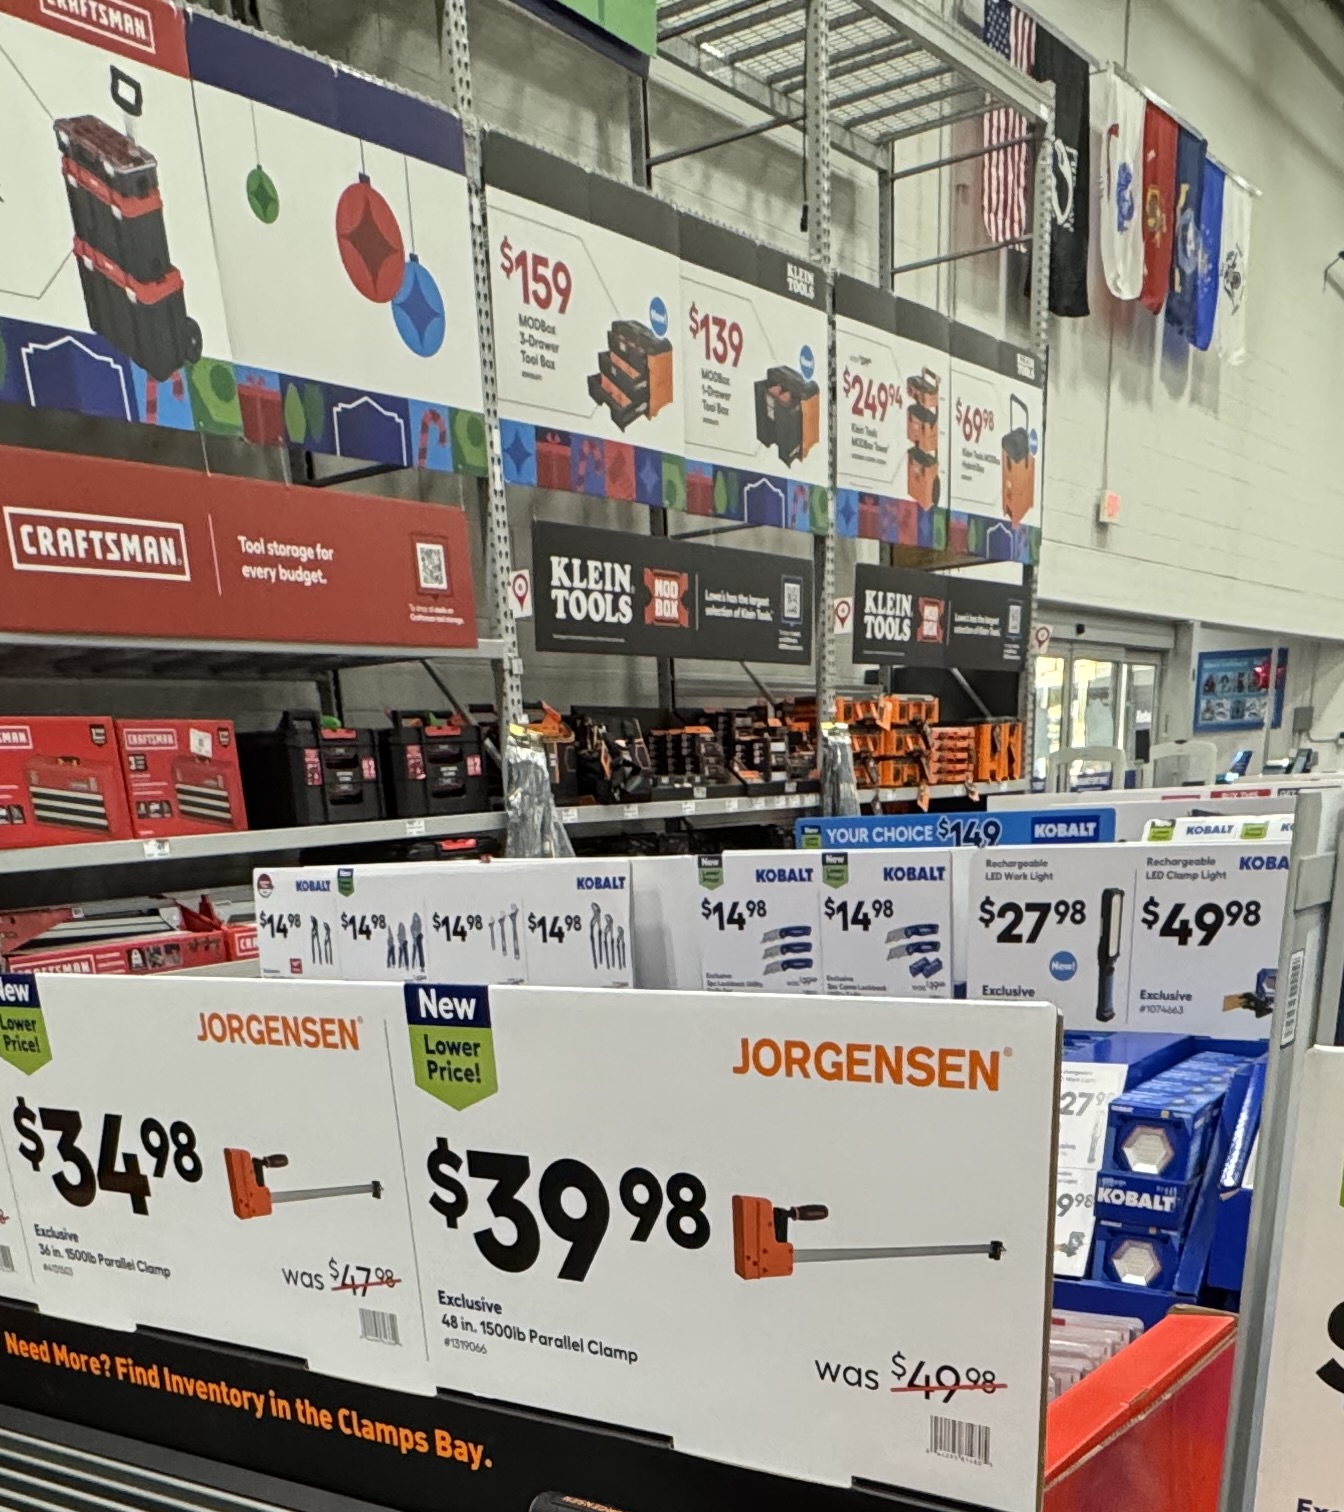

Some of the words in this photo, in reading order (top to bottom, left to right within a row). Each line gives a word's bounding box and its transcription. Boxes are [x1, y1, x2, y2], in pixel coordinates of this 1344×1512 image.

[500, 235, 572, 314] $159
[786, 262, 815, 284] KLEIN
[787, 277, 816, 300] TOOLS
[519, 313, 557, 336] MODBox
[689, 302, 743, 368] $139
[519, 332, 560, 354] 3-Drawer
[19, 523, 178, 565] CRAFTSMAN
[238, 534, 265, 554] Tool
[266, 541, 314, 562] storage
[315, 545, 334, 562] for
[241, 565, 276, 583] every
[278, 564, 327, 585] budget.
[551, 557, 632, 594] KLEIN
[654, 578, 679, 600] MOD
[552, 588, 633, 625] TOOLS
[655, 599, 679, 620] BOX
[864, 589, 912, 617] KLEIN
[864, 613, 912, 642] TOOLS
[826, 826, 869, 844] YOUR
[872, 825, 933, 842] CHOICE
[937, 817, 1001, 848] $149
[1033, 821, 1097, 839] KOBALT
[1186, 824, 1234, 836] KOBALT
[824, 854, 845, 865] New
[986, 858, 1048, 870] Rechargeable
[295, 880, 331, 892] KOBALT
[576, 876, 626, 890] KOBALT
[755, 867, 814, 884] KOBALT
[882, 866, 946, 882] KOBALT
[985, 871, 1002, 881] LED
[1004, 872, 1029, 881] Work
[1030, 872, 1053, 882] Light
[1145, 870, 1164, 880] LED
[1166, 871, 1198, 882] Clamp
[1200, 871, 1227, 882] Light
[1050, 959, 1077, 973] New!
[982, 984, 1035, 998] Exclusive
[1140, 989, 1192, 1004] Exclusive
[418, 990, 476, 1021] New
[2, 1031, 40, 1055] Price!
[197, 1013, 360, 1050] JORGENSEN
[423, 1034, 481, 1059] Lower
[427, 1060, 482, 1085] Price!
[732, 1038, 1000, 1091] JORGENSEN
[1096, 1187, 1176, 1212] KOBALT
[34, 1224, 79, 1244] Exclusive
[282, 1266, 325, 1290] was
[438, 1290, 503, 1316] Exclusive
[441, 1313, 459, 1331] 48
[461, 1316, 478, 1333] in.
[480, 1319, 527, 1343] 1500lb
[528, 1326, 585, 1354] Parallel
[587, 1337, 638, 1366] Clamp
[815, 1359, 881, 1393] was
[4, 1330, 50, 1364] Need
[53, 1341, 111, 1380] More?
[115, 1355, 159, 1390] Find
[163, 1367, 265, 1420] Inventory
[269, 1390, 291, 1420] in
[295, 1397, 333, 1431] the
[337, 1408, 429, 1455] Clamps
[434, 1428, 494, 1471] Bay.
